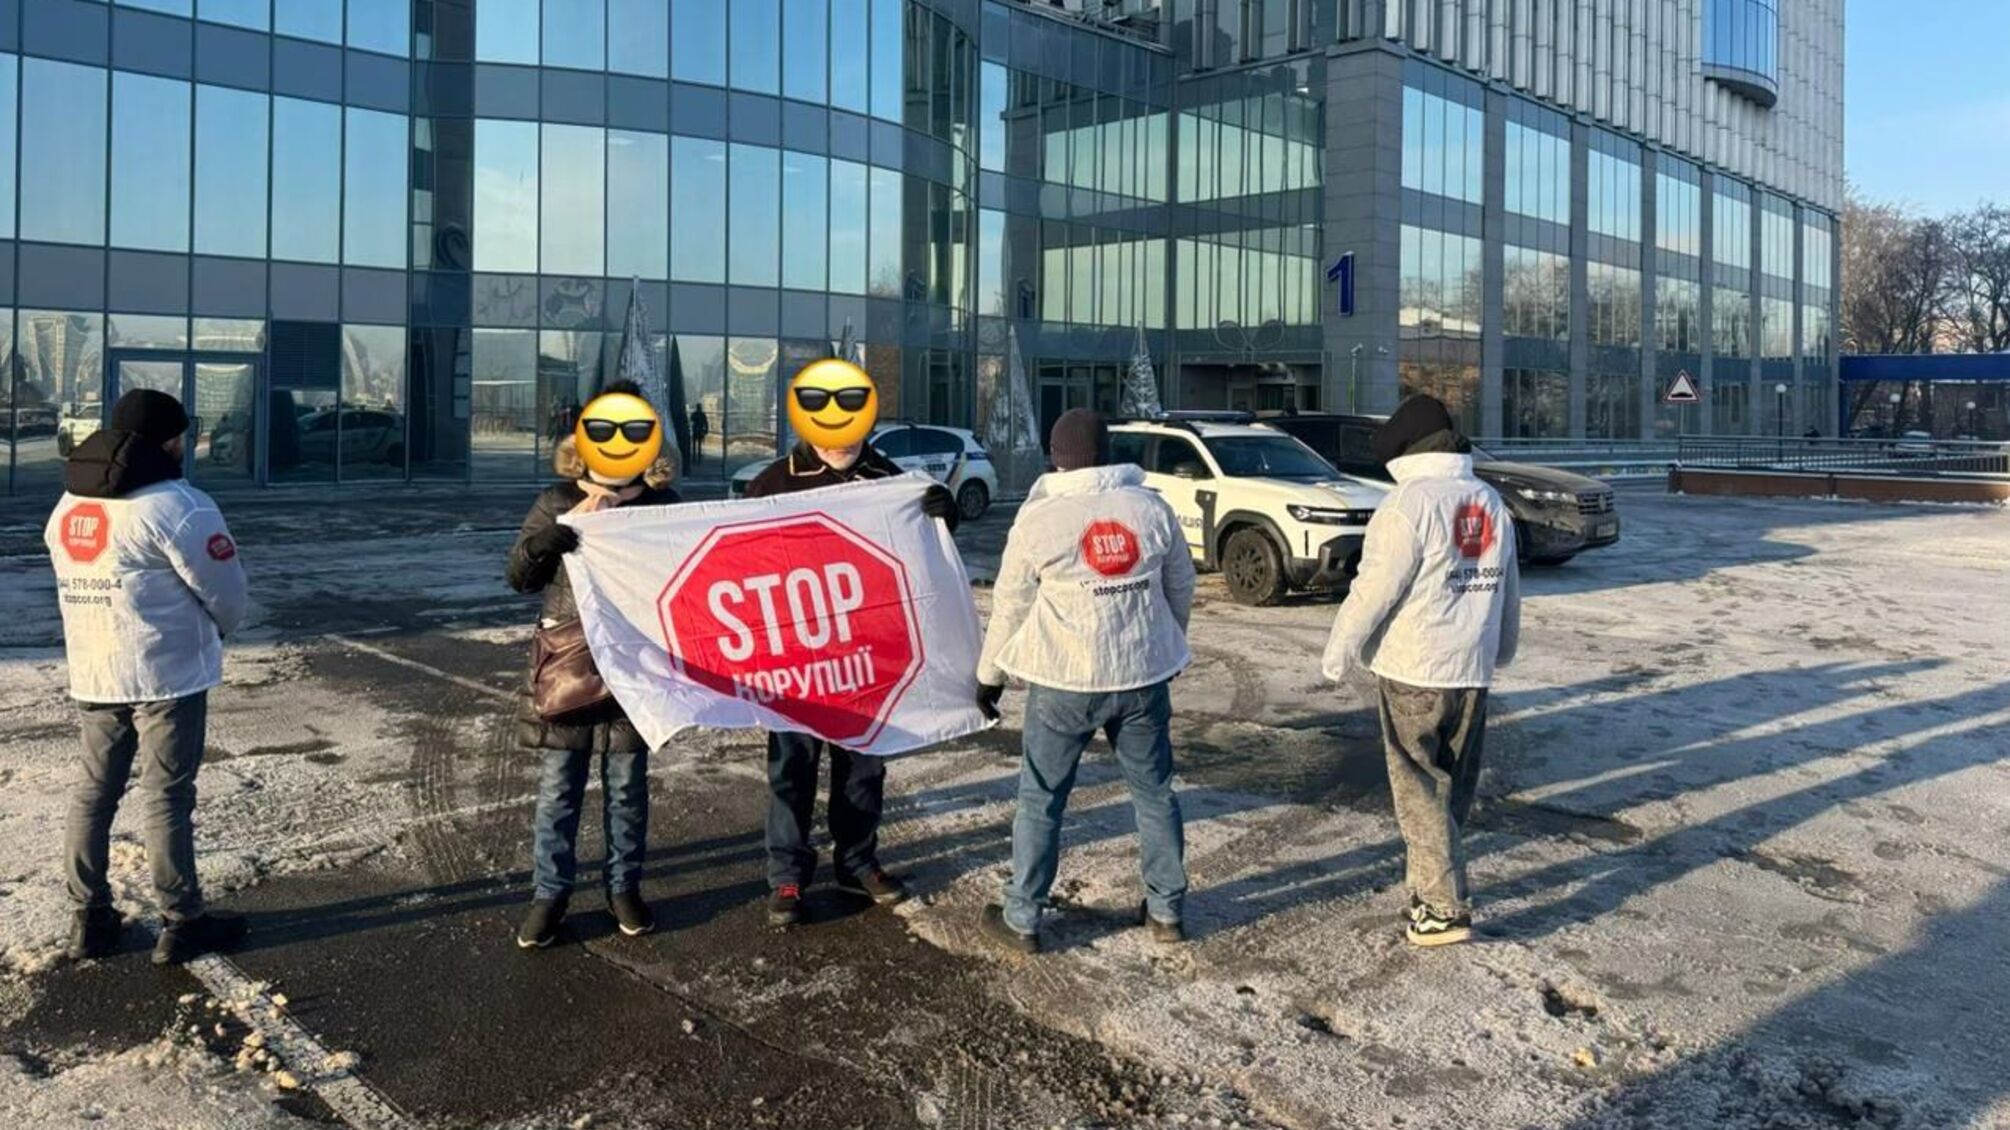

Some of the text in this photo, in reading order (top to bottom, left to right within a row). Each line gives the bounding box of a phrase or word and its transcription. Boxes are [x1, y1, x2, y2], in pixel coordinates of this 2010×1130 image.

[1326, 251, 1355, 317] 1
[69, 515, 100, 538] STOP
[1093, 534, 1126, 554] STOP
[707, 561, 864, 663] STOP
[731, 645, 877, 704] КОРУПЦІЇ
